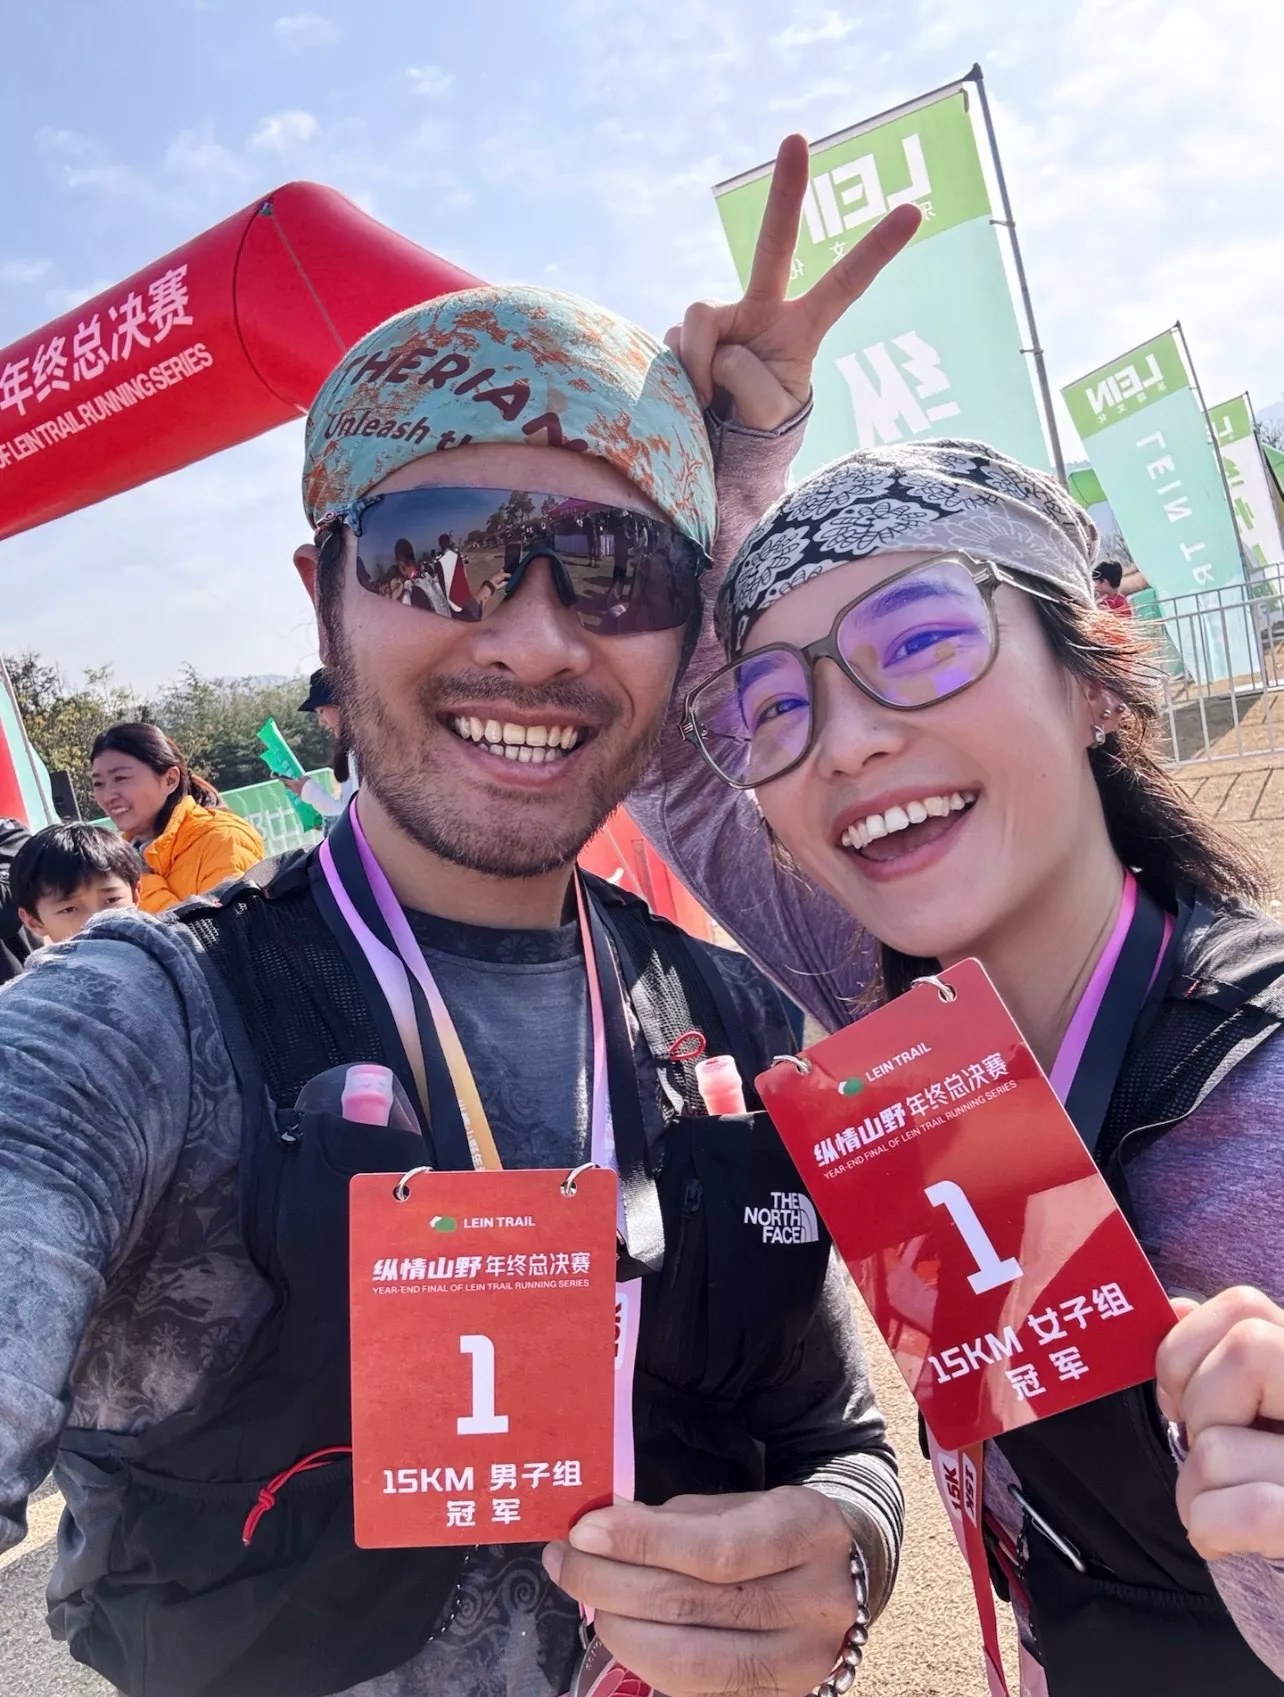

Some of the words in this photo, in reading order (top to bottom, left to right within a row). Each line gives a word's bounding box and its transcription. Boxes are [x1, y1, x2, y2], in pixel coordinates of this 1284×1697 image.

[0, 264, 193, 416] 年终总决赛
[12, 429, 40, 460] LEIN
[36, 410, 86, 446] TRAIL
[77, 373, 155, 427] RUNNING
[150, 342, 214, 390] SERIES
[324, 410, 430, 444] Unleash
[865, 1061, 895, 1083] LEIN
[895, 1042, 932, 1064] TRAIL
[823, 1156, 865, 1180] YEAR-END
[864, 1145, 889, 1161] FINAL
[888, 1137, 901, 1149] OF
[901, 1127, 921, 1143] LEIN
[920, 1117, 947, 1133] TRAIL
[946, 1096, 986, 1120] RUNNING
[985, 1080, 1017, 1101] SERIES
[463, 1217, 494, 1229] LEIN
[497, 1216, 536, 1228] TRAIL
[743, 1206, 801, 1227] NORTH
[770, 1192, 800, 1209] THE
[762, 1226, 801, 1244] FACE
[924, 1179, 1024, 1296] 1
[372, 1286, 421, 1295] YEAR-END
[422, 1285, 449, 1293] FINAL
[451, 1284, 463, 1292] OF
[465, 1283, 486, 1292] LEIN
[487, 1282, 513, 1291] TRAIL
[515, 1280, 557, 1290] RUNNING
[558, 1279, 589, 1287] SERIES
[927, 1325, 1024, 1384] 15KM
[1027, 1282, 1134, 1346] 女子组
[457, 1334, 509, 1435] 1
[383, 1466, 475, 1494] 15KM
[489, 1460, 582, 1491] 男子组
[942, 1462, 963, 1511] 15K
[965, 1464, 976, 1518] 15K
